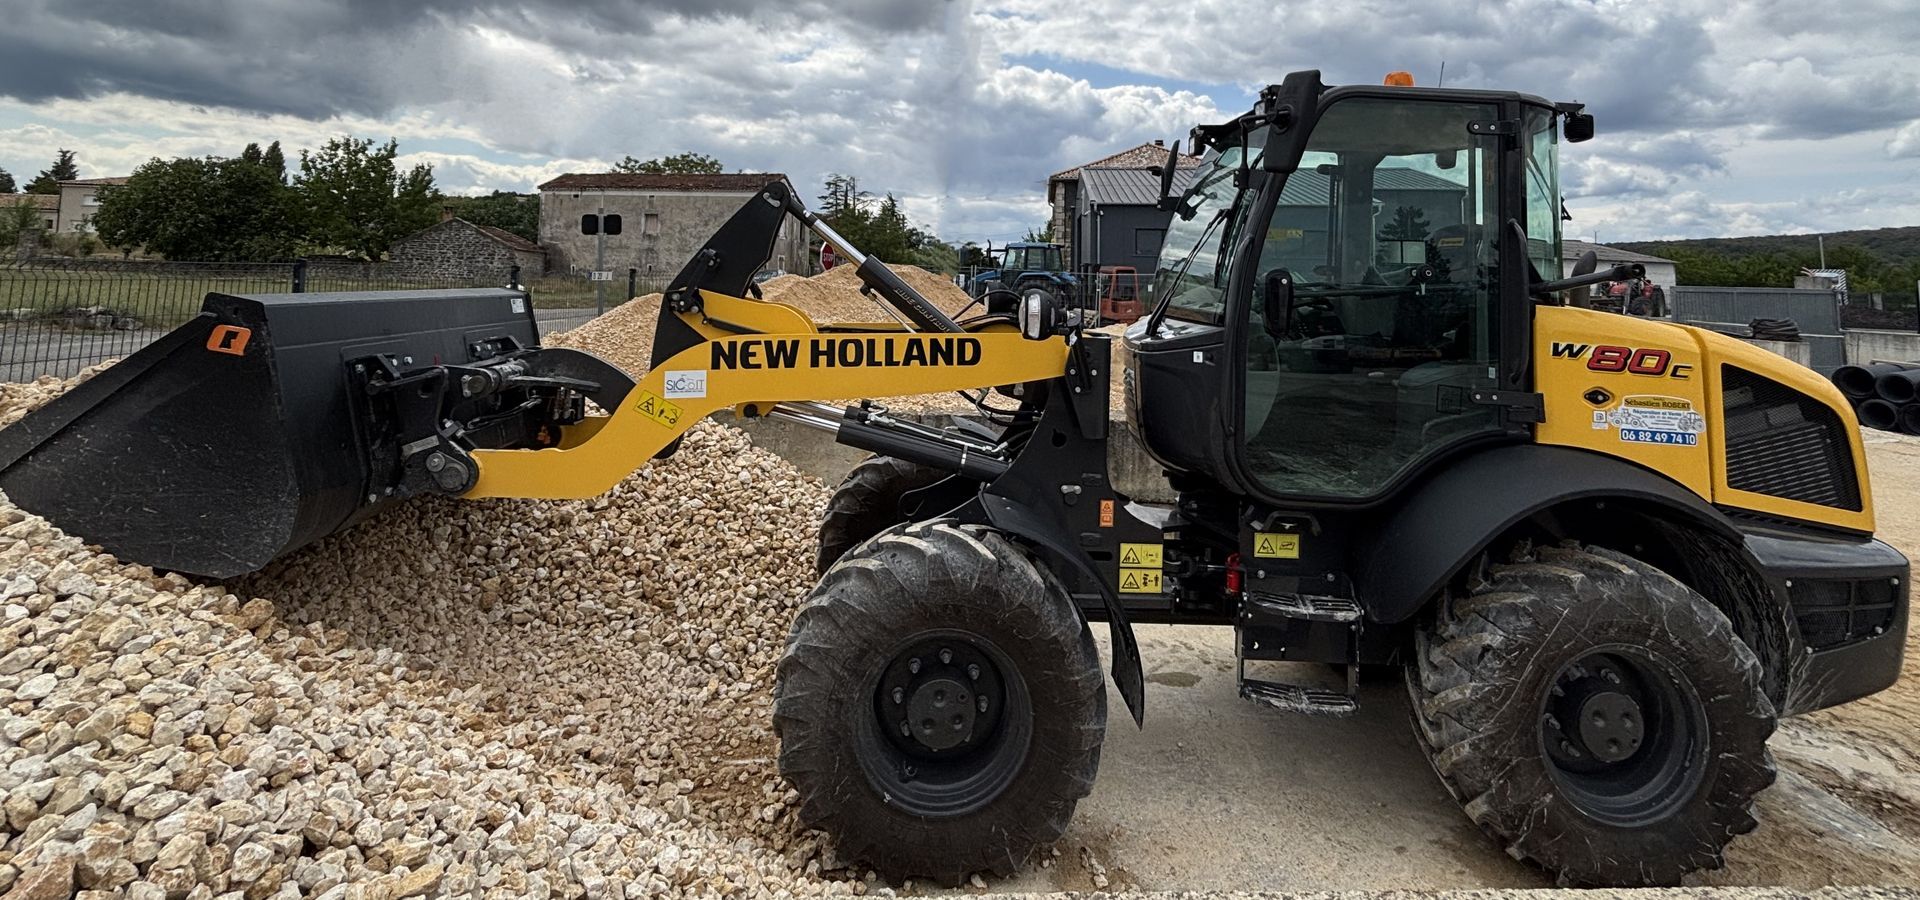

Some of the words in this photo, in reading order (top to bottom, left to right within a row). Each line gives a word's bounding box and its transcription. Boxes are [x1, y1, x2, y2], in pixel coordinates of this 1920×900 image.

[711, 340, 800, 370] NEW
[810, 338, 982, 368] HOLLAND
[1662, 401, 1691, 409] ROBERT
[1622, 431, 1636, 440] 06
[1638, 432, 1652, 441] 82
[1654, 433, 1668, 442] 49
[1671, 434, 1682, 443] 74
[1685, 435, 1695, 444] 10
